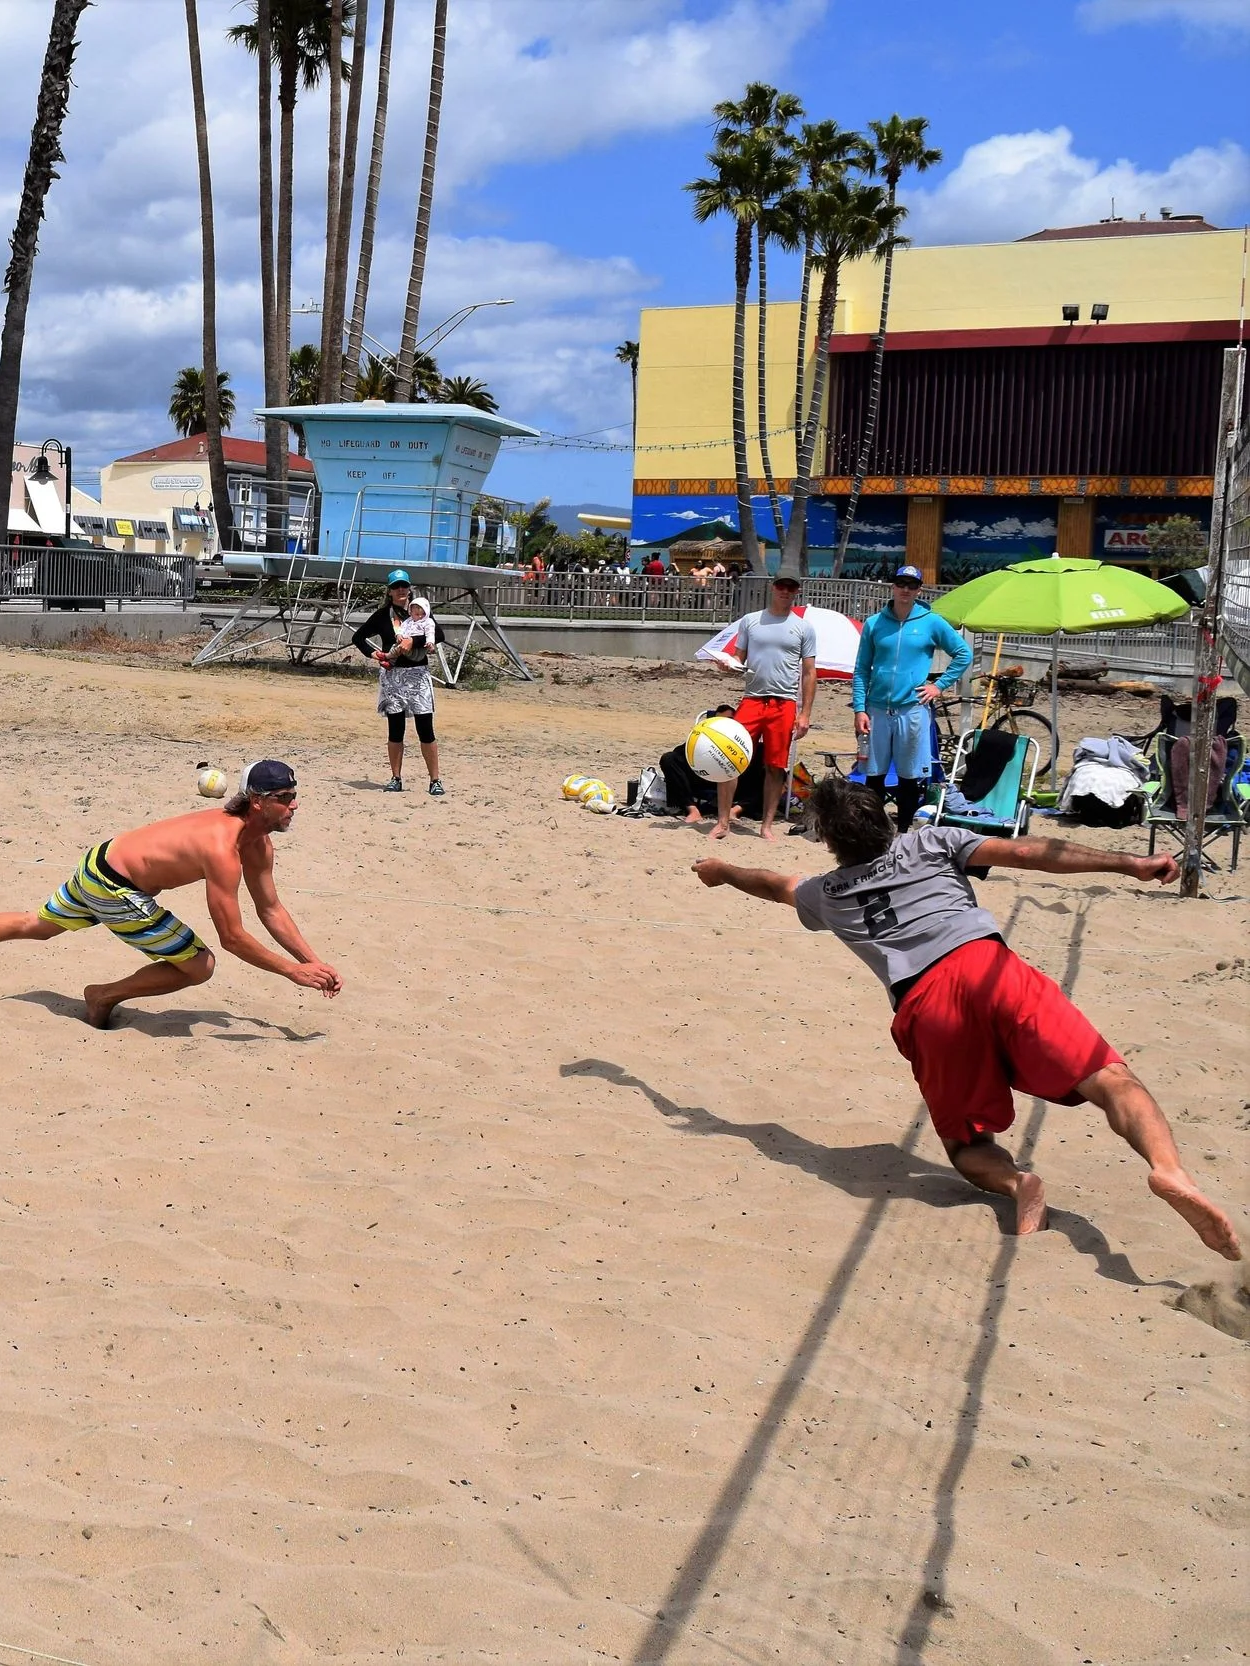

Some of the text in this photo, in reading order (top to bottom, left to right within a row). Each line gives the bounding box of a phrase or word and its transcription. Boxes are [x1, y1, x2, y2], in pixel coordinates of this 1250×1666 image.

[338, 440, 381, 448] LIFEGUARD
[408, 441, 429, 450] DUTY
[347, 470, 397, 480] KEEP OFF
[830, 882, 850, 894] SAN
[856, 889, 899, 939] 2
